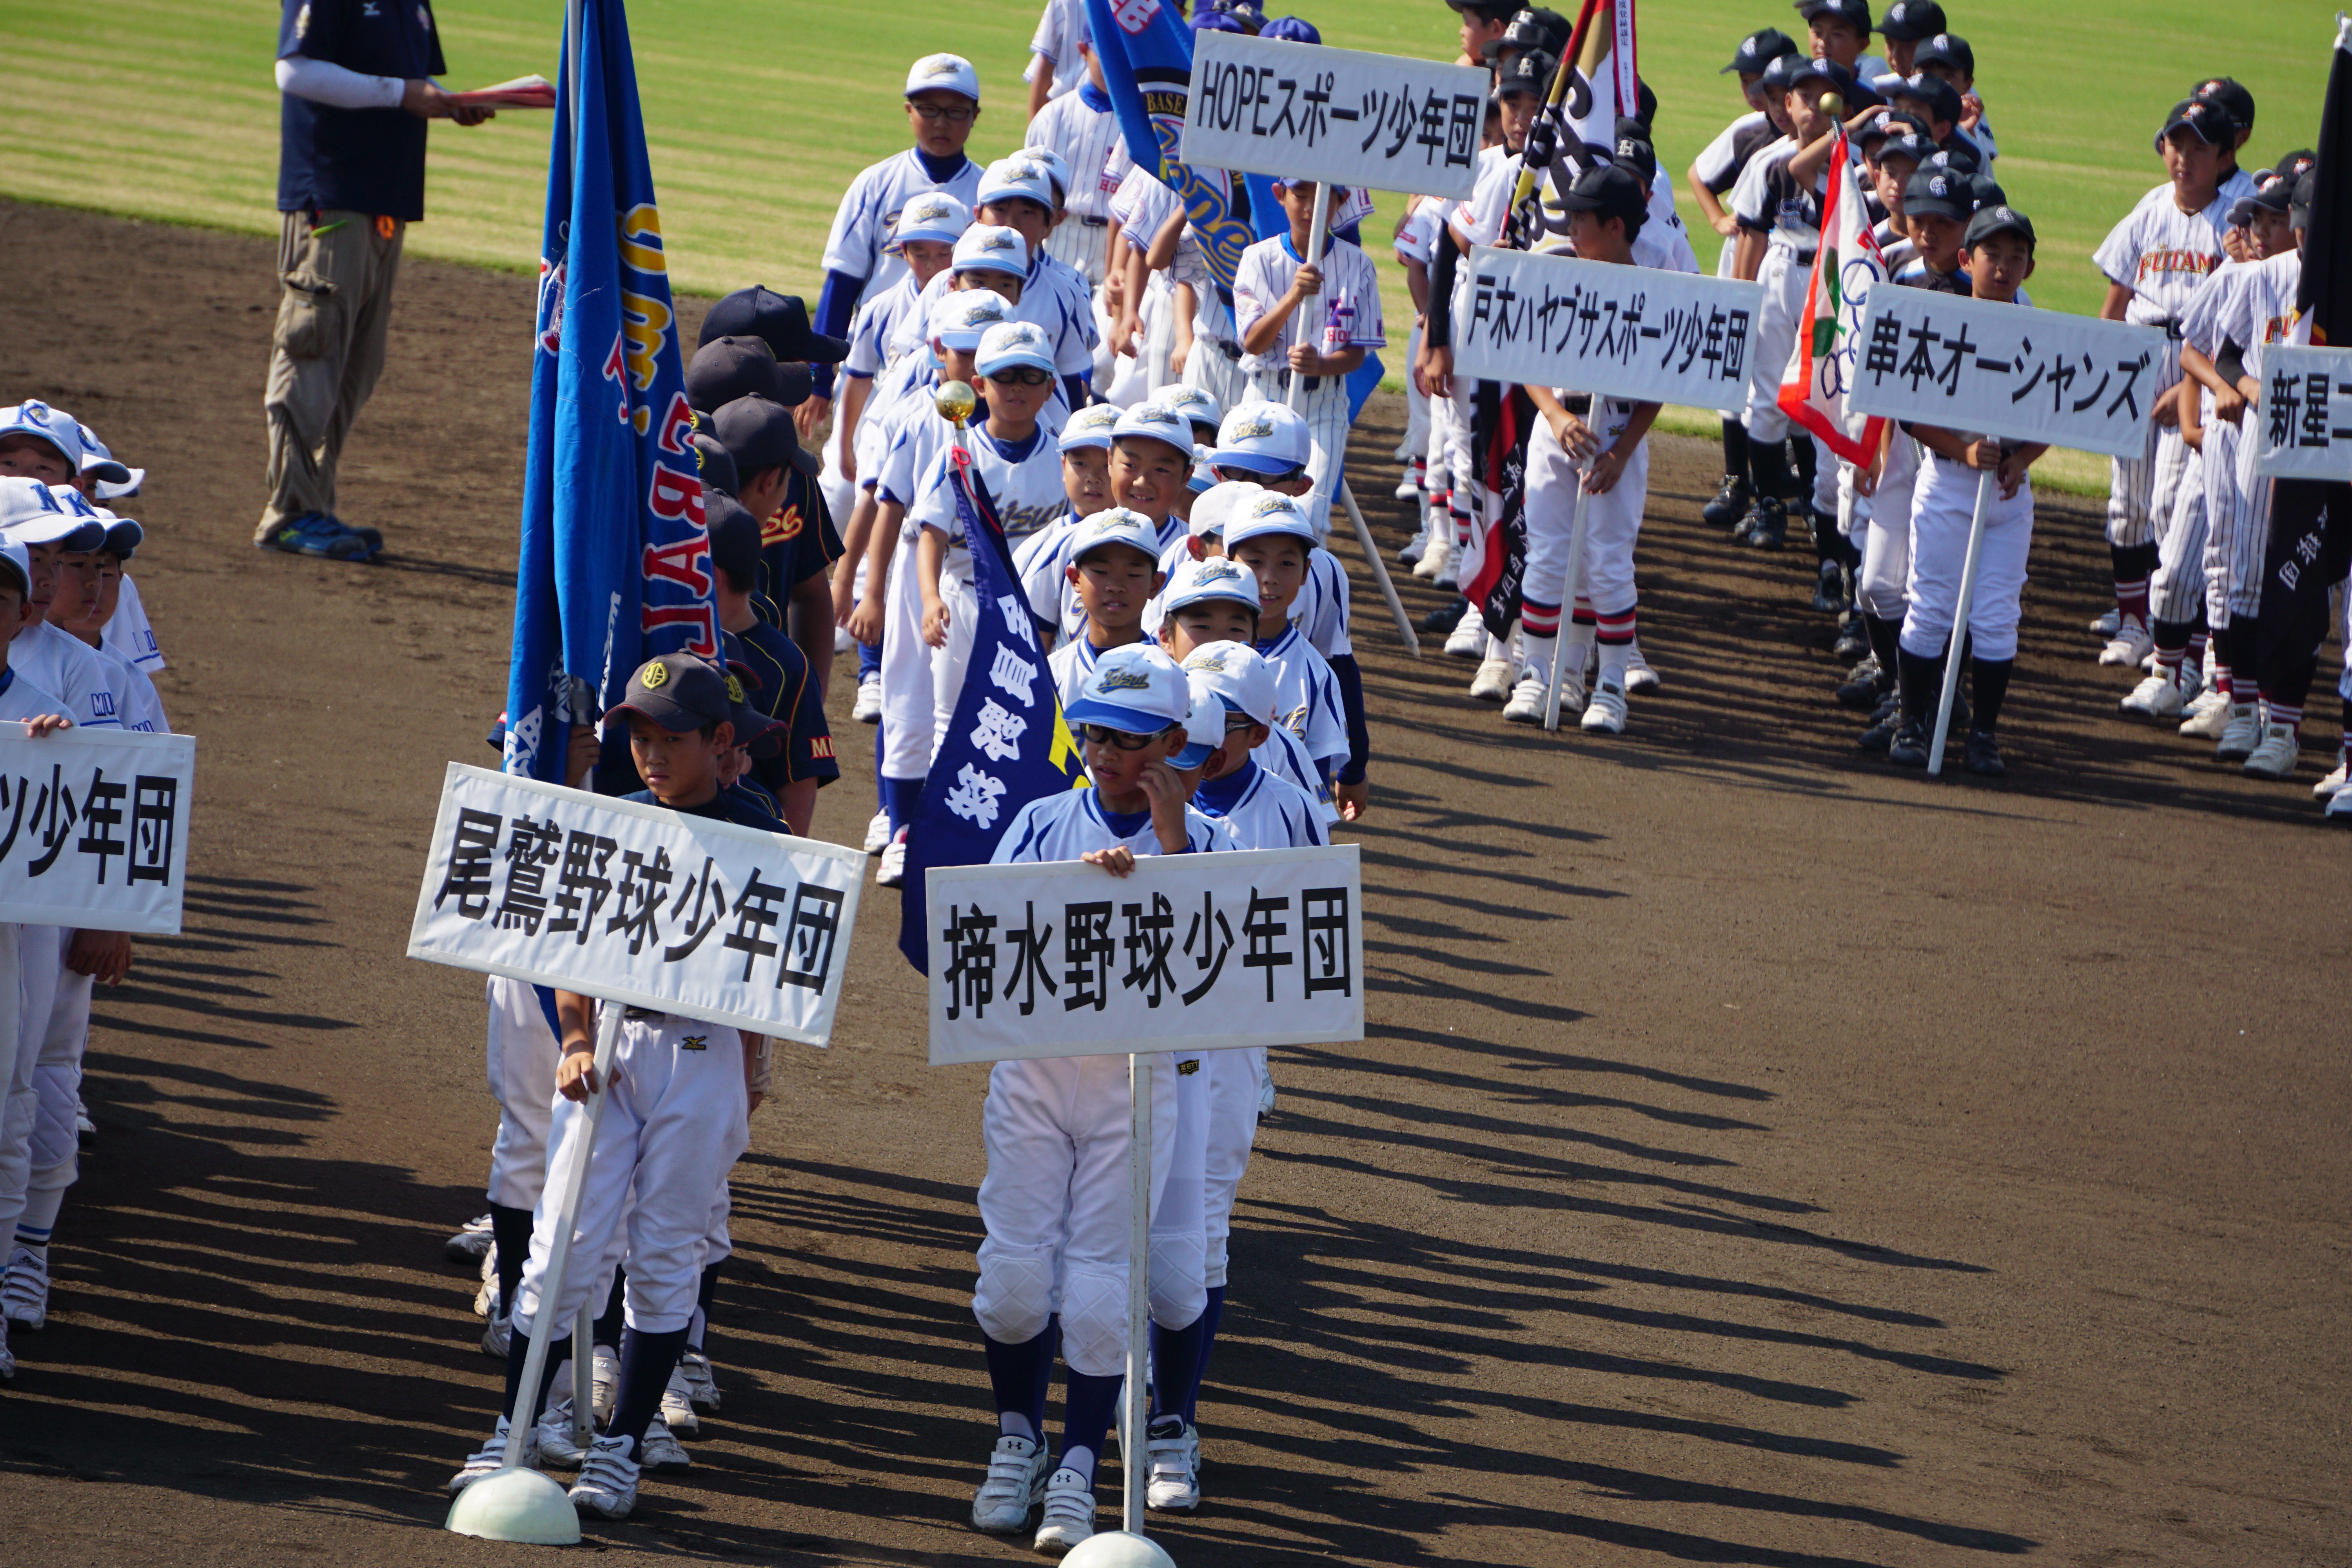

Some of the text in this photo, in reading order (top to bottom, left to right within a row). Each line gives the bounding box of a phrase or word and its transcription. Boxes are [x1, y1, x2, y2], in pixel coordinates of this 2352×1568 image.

[1146, 93, 1186, 114] BASE
[1197, 60, 1479, 169] HOPEスポーツ少年団
[1467, 274, 1749, 383] 戸木ハヤブサスポーツ少年団
[1866, 309, 2151, 422] 串本オーシャンズ
[1095, 666, 1151, 694] Teisui
[0, 763, 177, 887] ツ少年団
[434, 807, 845, 998] 尾鷲野球少年団
[943, 886, 1352, 1021] 揥水野球少年団
[1180, 1061, 1198, 1071] ZETT
